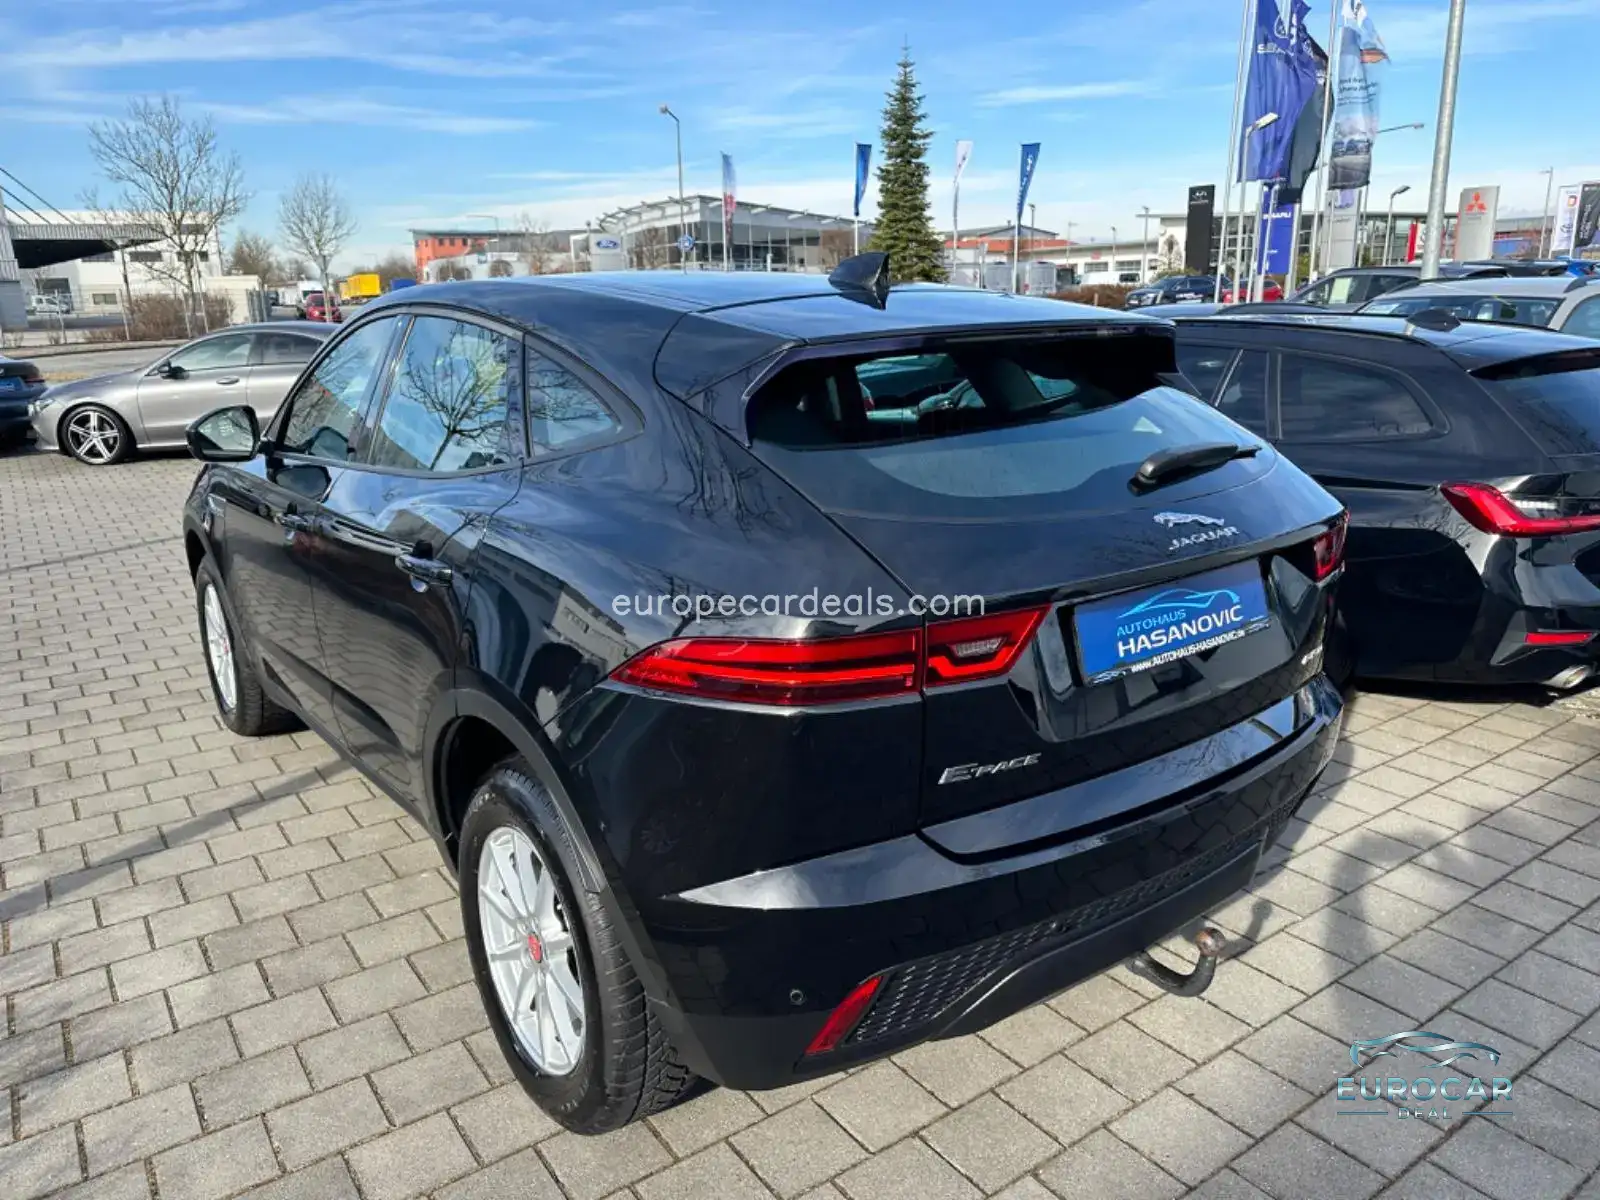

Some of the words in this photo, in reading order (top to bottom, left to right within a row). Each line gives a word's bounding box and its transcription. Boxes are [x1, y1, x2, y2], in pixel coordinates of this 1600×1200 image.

[1169, 526, 1239, 550] JAGUAR
[1117, 609, 1187, 637] AUTOHAUS
[1117, 604, 1244, 658] HASANOVIC
